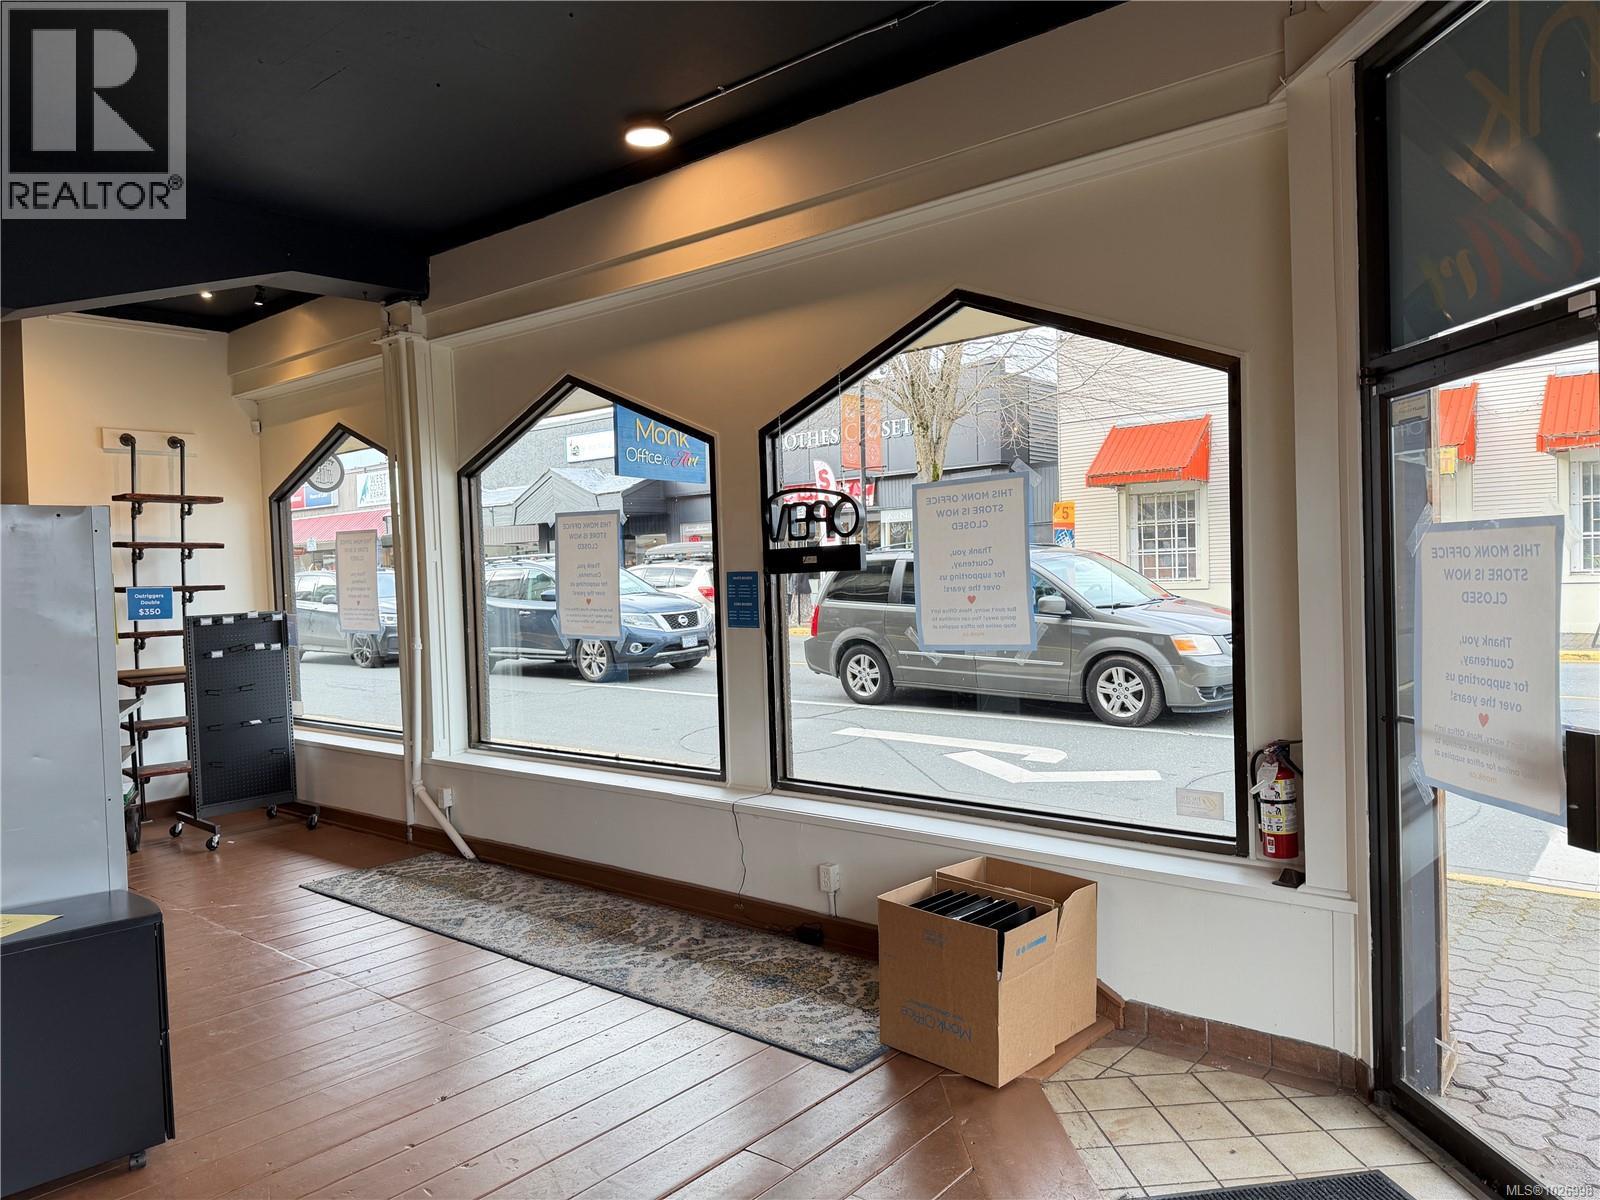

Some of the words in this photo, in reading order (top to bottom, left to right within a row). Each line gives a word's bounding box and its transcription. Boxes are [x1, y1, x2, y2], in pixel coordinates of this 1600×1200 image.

[635, 418, 690, 449] Monk
[782, 428, 841, 451] OTHES
[881, 418, 914, 438] SET
[625, 446, 662, 465] Office
[671, 450, 699, 468] Art
[138, 608, 161, 616] $350
